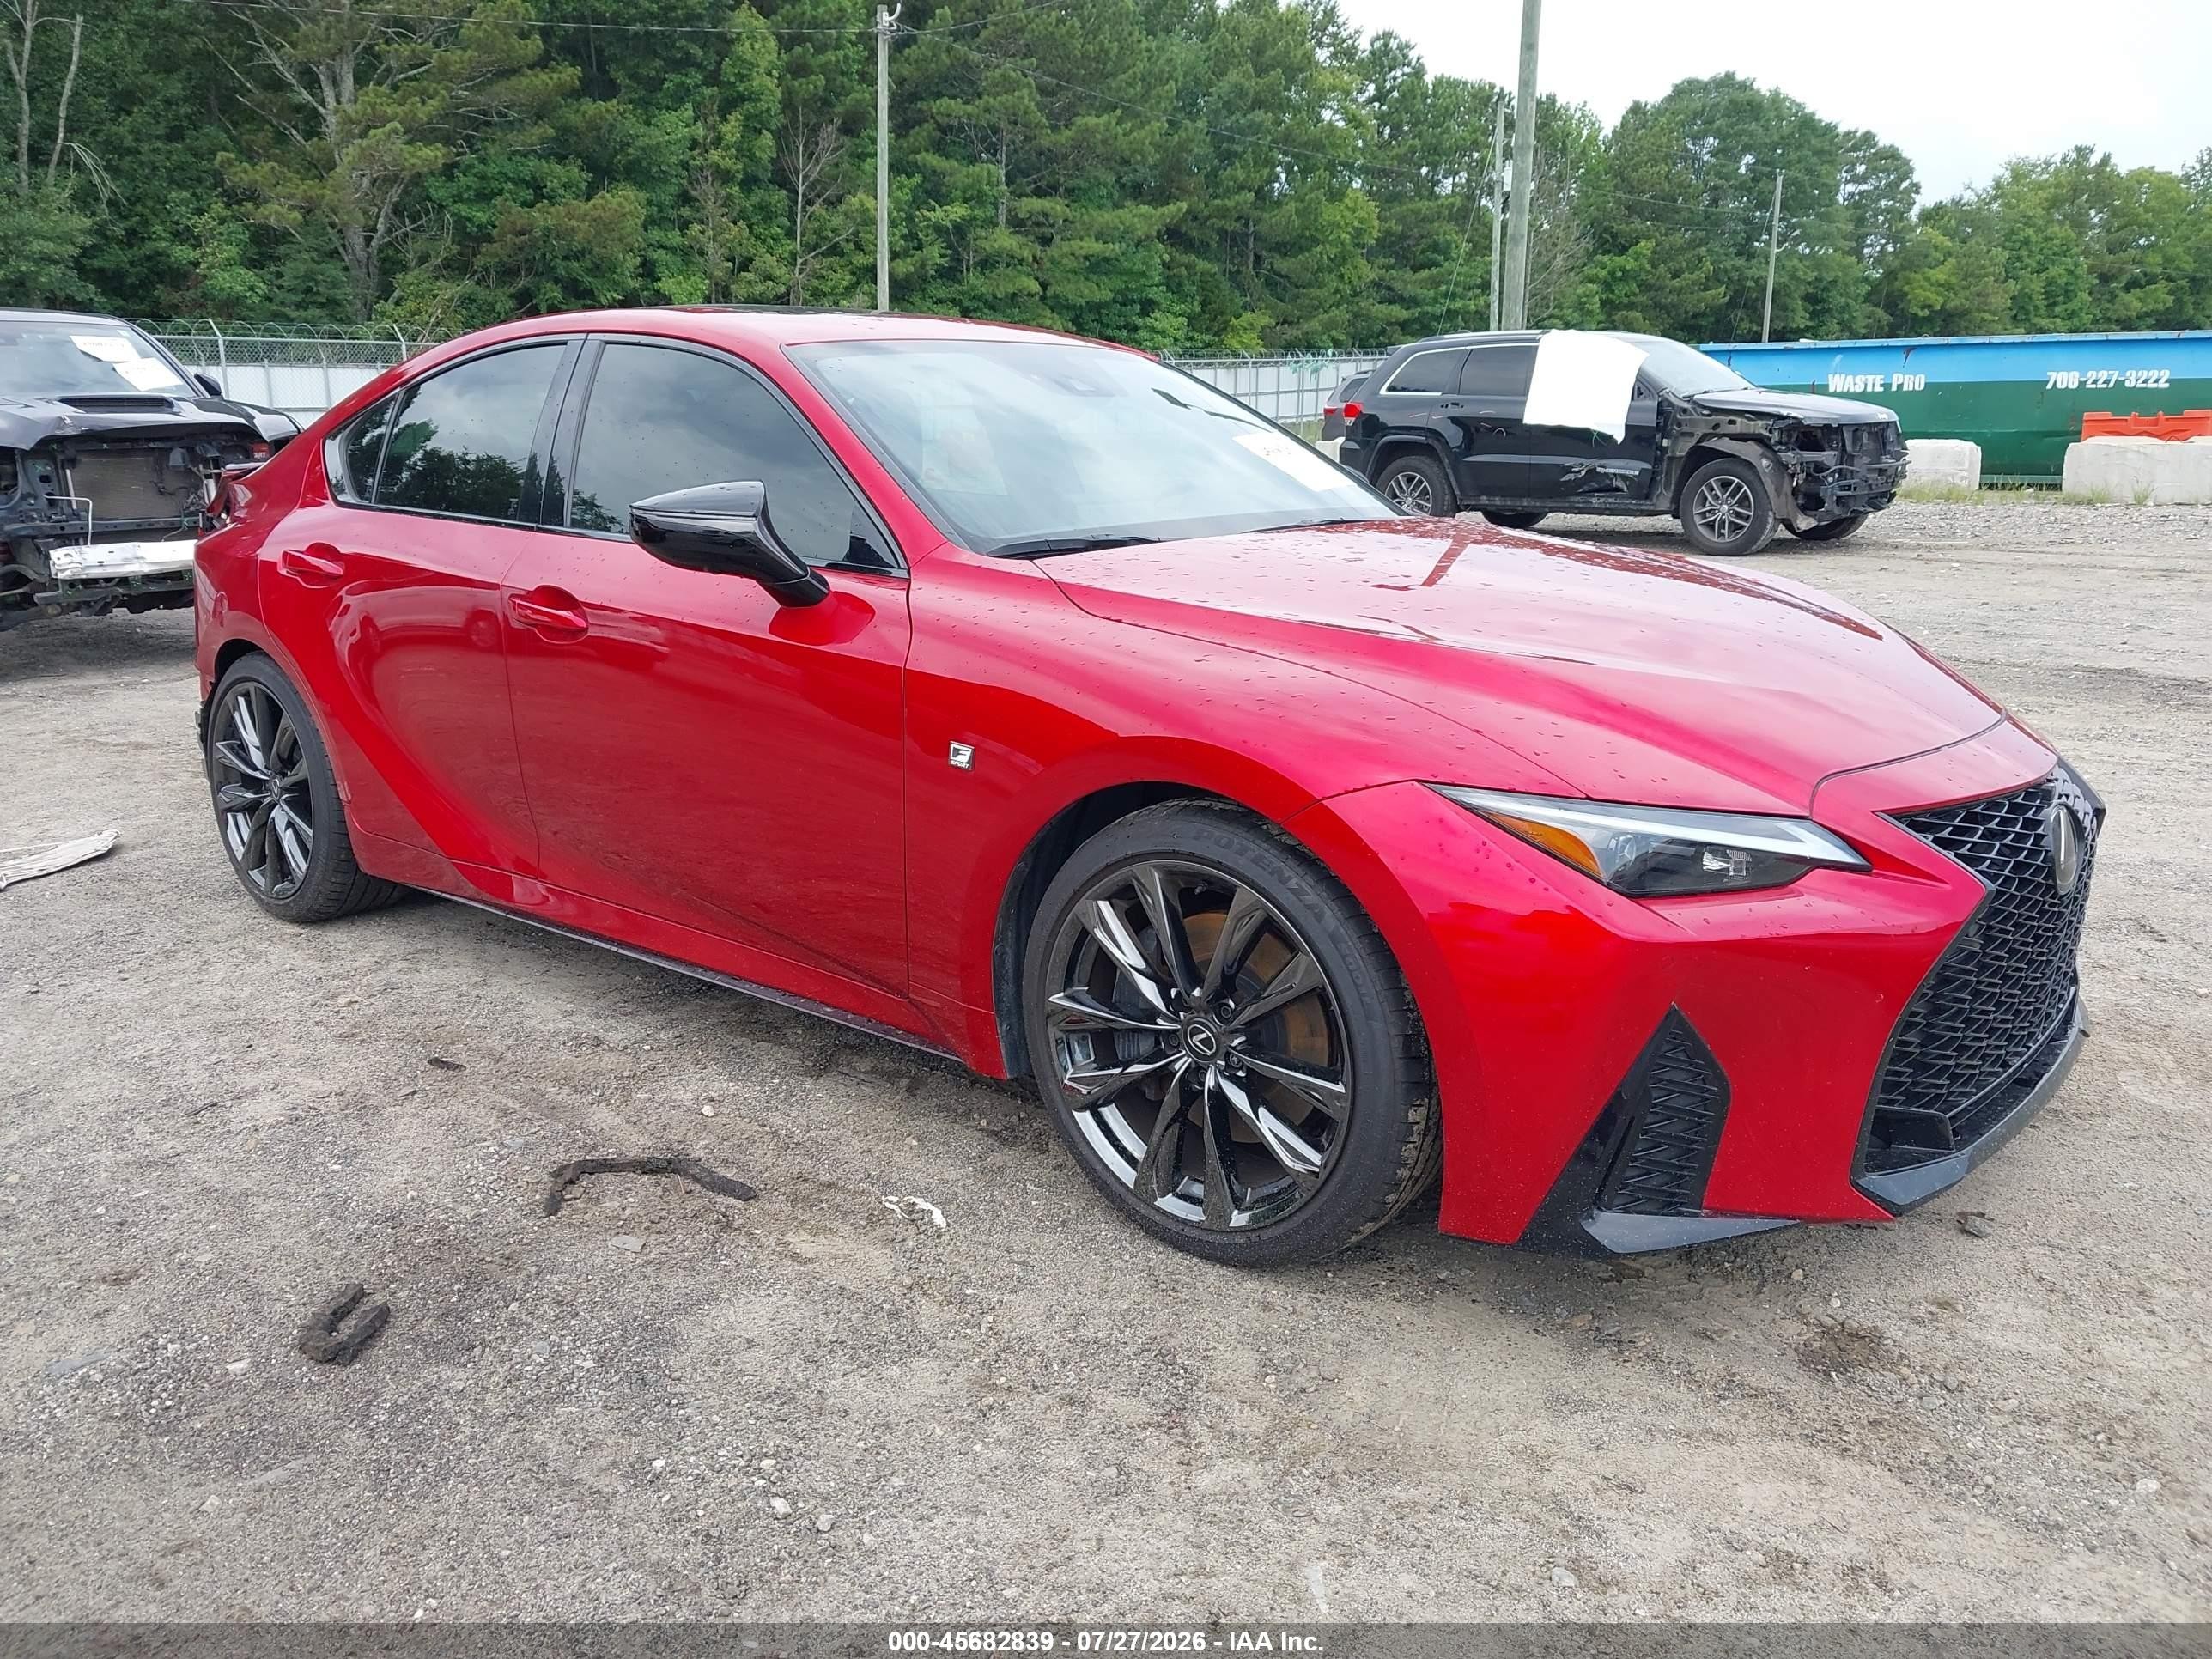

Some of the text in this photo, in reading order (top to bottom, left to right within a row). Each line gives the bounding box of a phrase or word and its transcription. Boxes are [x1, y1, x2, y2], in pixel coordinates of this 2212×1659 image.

[1827, 373, 1926, 392] WASTE PRO
[2045, 369, 2171, 389] 706-227-3222
[951, 760, 970, 769] SPORT
[1193, 828, 1328, 925] POTENZA
